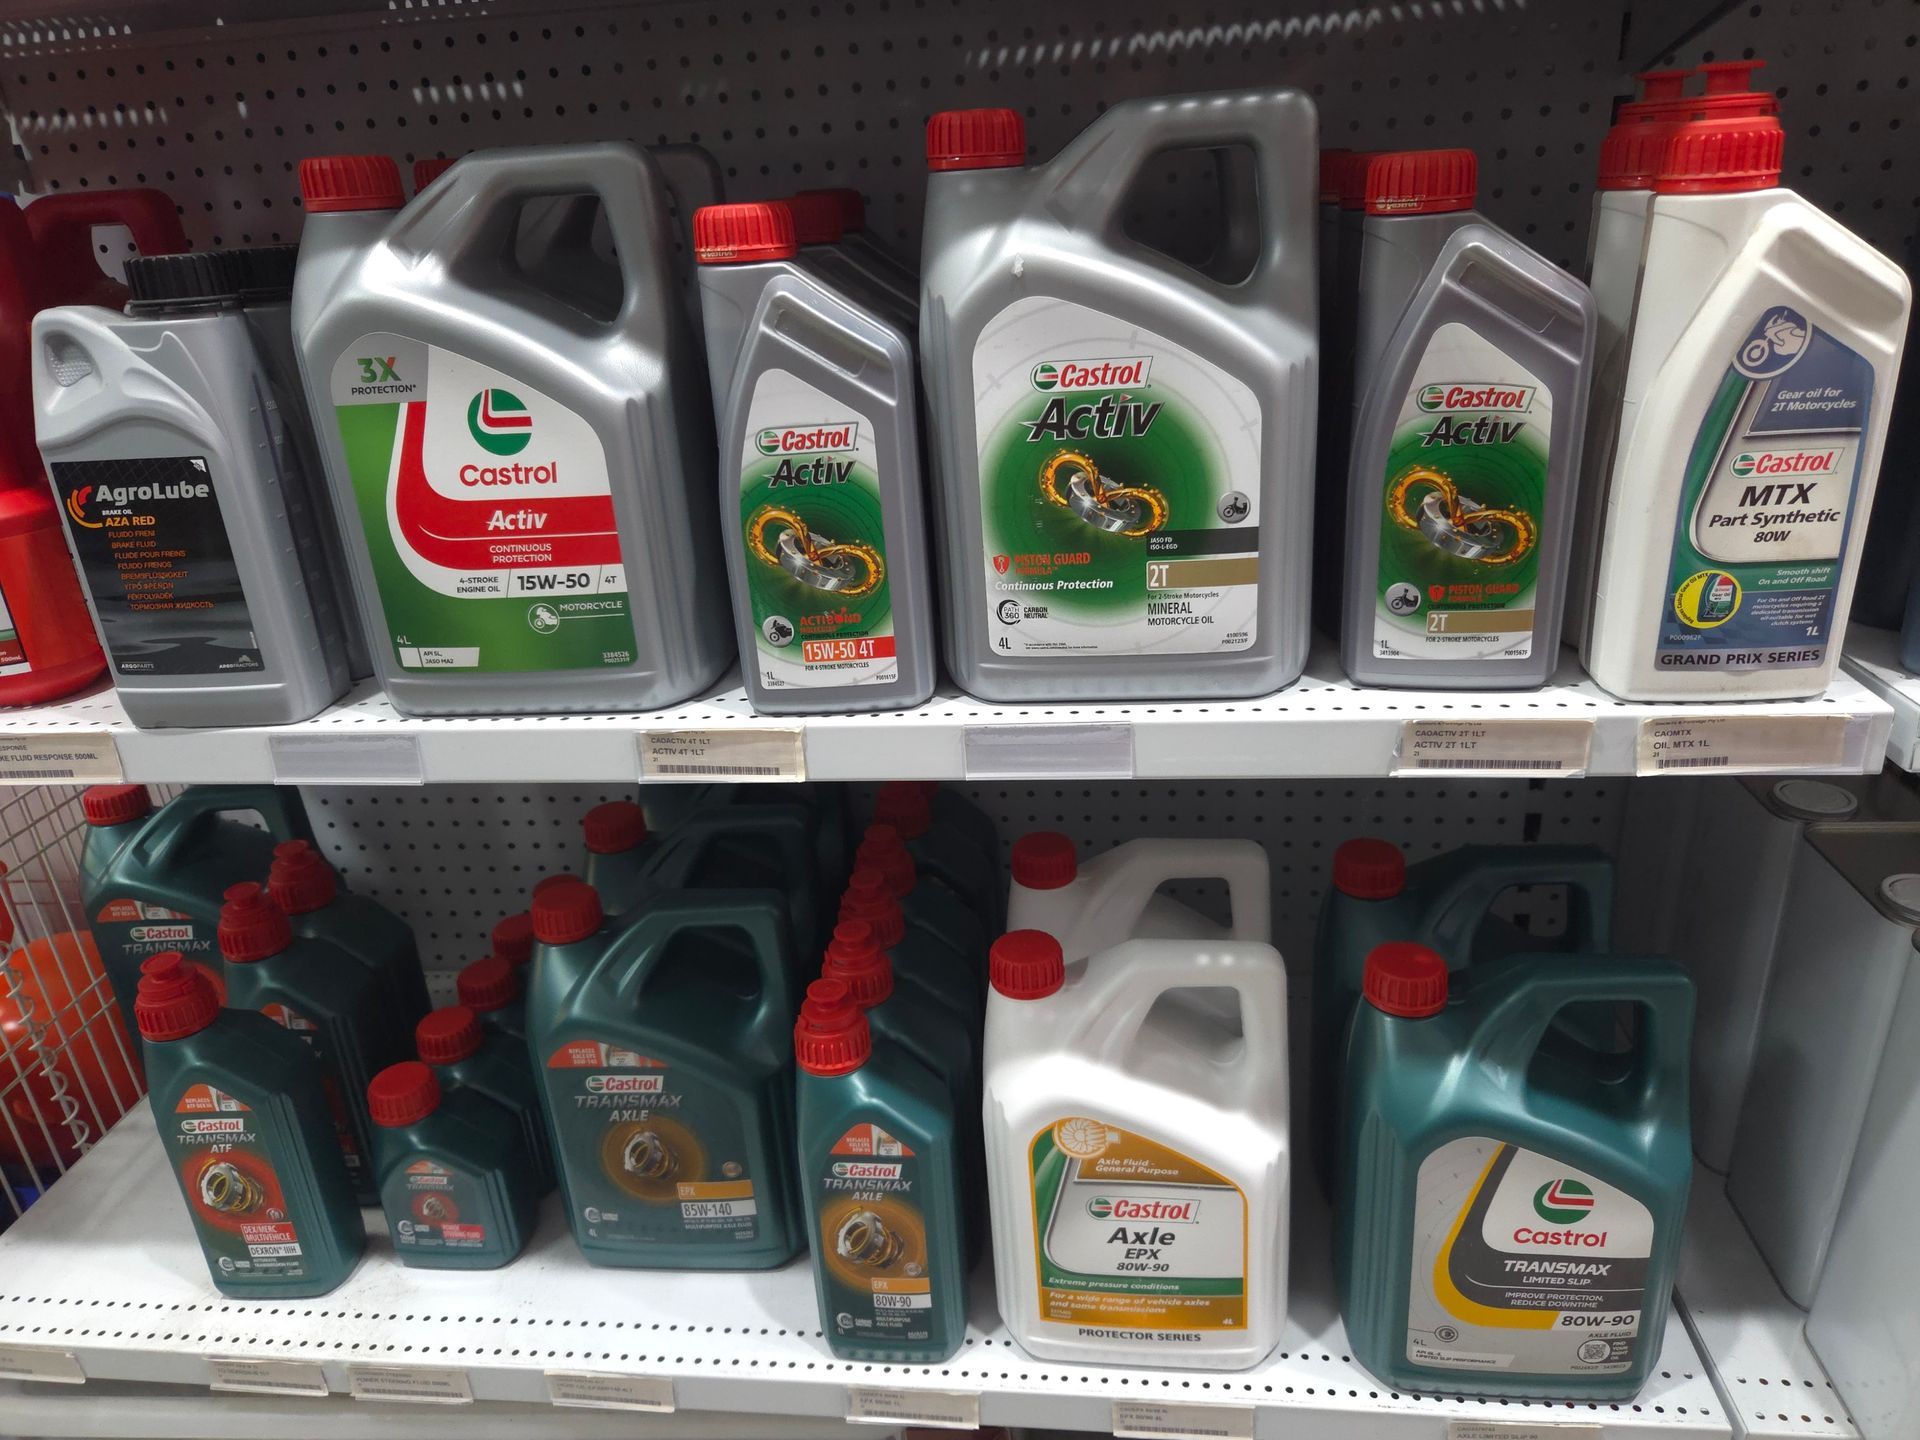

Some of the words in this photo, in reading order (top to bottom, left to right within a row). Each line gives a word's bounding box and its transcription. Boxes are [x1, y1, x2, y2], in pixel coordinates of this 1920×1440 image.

[357, 356, 402, 383] 3X
[1060, 361, 1142, 388] Castrol
[1446, 387, 1525, 409] Castrol
[1778, 390, 1804, 400] Gear
[1806, 388, 1822, 398] oil
[1824, 387, 1842, 398] for
[1771, 402, 1786, 412] 2T
[1787, 399, 1857, 411] Motorcycles
[1022, 393, 1165, 442] Activ
[1420, 416, 1526, 448] Activ
[781, 427, 850, 451] Castrol
[1755, 451, 1834, 474] Castrol
[459, 461, 558, 487] Castrol
[766, 456, 857, 489] Activ
[96, 480, 210, 506] AgroLube
[1738, 482, 1818, 508] MTX
[105, 518, 129, 527] AZA
[132, 516, 156, 526] RED
[487, 508, 547, 531] Activ
[1708, 512, 1748, 528] Part
[1750, 509, 1840, 528] Synthetic
[1753, 530, 1791, 543] 80W
[489, 543, 552, 554] CONTINUOUS
[492, 554, 552, 564] PROTECTION
[1054, 552, 1091, 564] GUARD
[460, 576, 499, 585] 4-STROKE
[517, 572, 590, 592] 15W-50
[604, 574, 617, 584] 4T
[1150, 564, 1170, 587] 2T
[457, 586, 486, 594] ENGINE
[487, 585, 500, 593] OIL
[994, 581, 1054, 591] Continuous
[1056, 578, 1114, 590] Protection
[1448, 585, 1482, 594] PISTON
[1184, 592, 1219, 600] Motorcycles
[560, 601, 623, 612] MOTORCYCLE
[1148, 602, 1192, 615] MINERAL
[1148, 617, 1199, 626] MOTORCYCLE
[1201, 616, 1214, 624] OIL
[1429, 614, 1448, 631] 2T
[1806, 626, 1819, 636] 1L
[396, 635, 412, 645] 4L
[999, 637, 1012, 650] 4L
[1380, 640, 1389, 648] 1L
[805, 641, 856, 660] 15W-50
[859, 640, 875, 657] 4T
[1661, 653, 1721, 665] GRAND
[1726, 652, 1763, 664] PRIX
[1768, 650, 1820, 664] SERIES
[766, 672, 775, 680] 1L
[146, 928, 190, 939] Castrol
[122, 940, 211, 954] TRANSMAX
[605, 1077, 658, 1091] Castrol
[574, 1095, 683, 1108] TRANSMAX
[609, 1110, 649, 1122] AXLE
[197, 1120, 241, 1132] Castrol
[177, 1133, 256, 1144] TRANSMAX
[210, 1144, 232, 1154] ATF
[1123, 1158, 1150, 1166] Fluid
[849, 1164, 897, 1177] Castrol
[1096, 1166, 1136, 1174] General
[1138, 1167, 1179, 1176] Purpose
[824, 1178, 912, 1191] TRANSMAX
[852, 1192, 883, 1201] AXLE
[684, 1203, 732, 1216] 85W-140
[1114, 1200, 1190, 1220] Castrol
[1107, 1227, 1176, 1246] Axle
[1513, 1228, 1608, 1247] Castrol
[1124, 1248, 1161, 1260] EPX
[1116, 1262, 1170, 1272] 80W-90
[1504, 1260, 1612, 1276] TRANSMAX
[874, 1281, 888, 1290] EPX
[1049, 1277, 1086, 1287] Extreme
[1130, 1282, 1180, 1290] conditions
[1522, 1275, 1565, 1285] LIMITED
[1567, 1277, 1591, 1286] SLIP
[875, 1296, 912, 1308] 80W-90
[1050, 1292, 1066, 1300] For
[1147, 1298, 1181, 1306] vehicle
[1505, 1292, 1545, 1300] IMPROVE
[1547, 1293, 1604, 1302] PROTECTION,
[1511, 1299, 1546, 1307] REDUCE
[1548, 1300, 1598, 1308] DOWNTIME
[1561, 1315, 1635, 1326] 80W-90
[1078, 1328, 1153, 1340] PROTECTOR
[1158, 1332, 1202, 1342] SERIES
